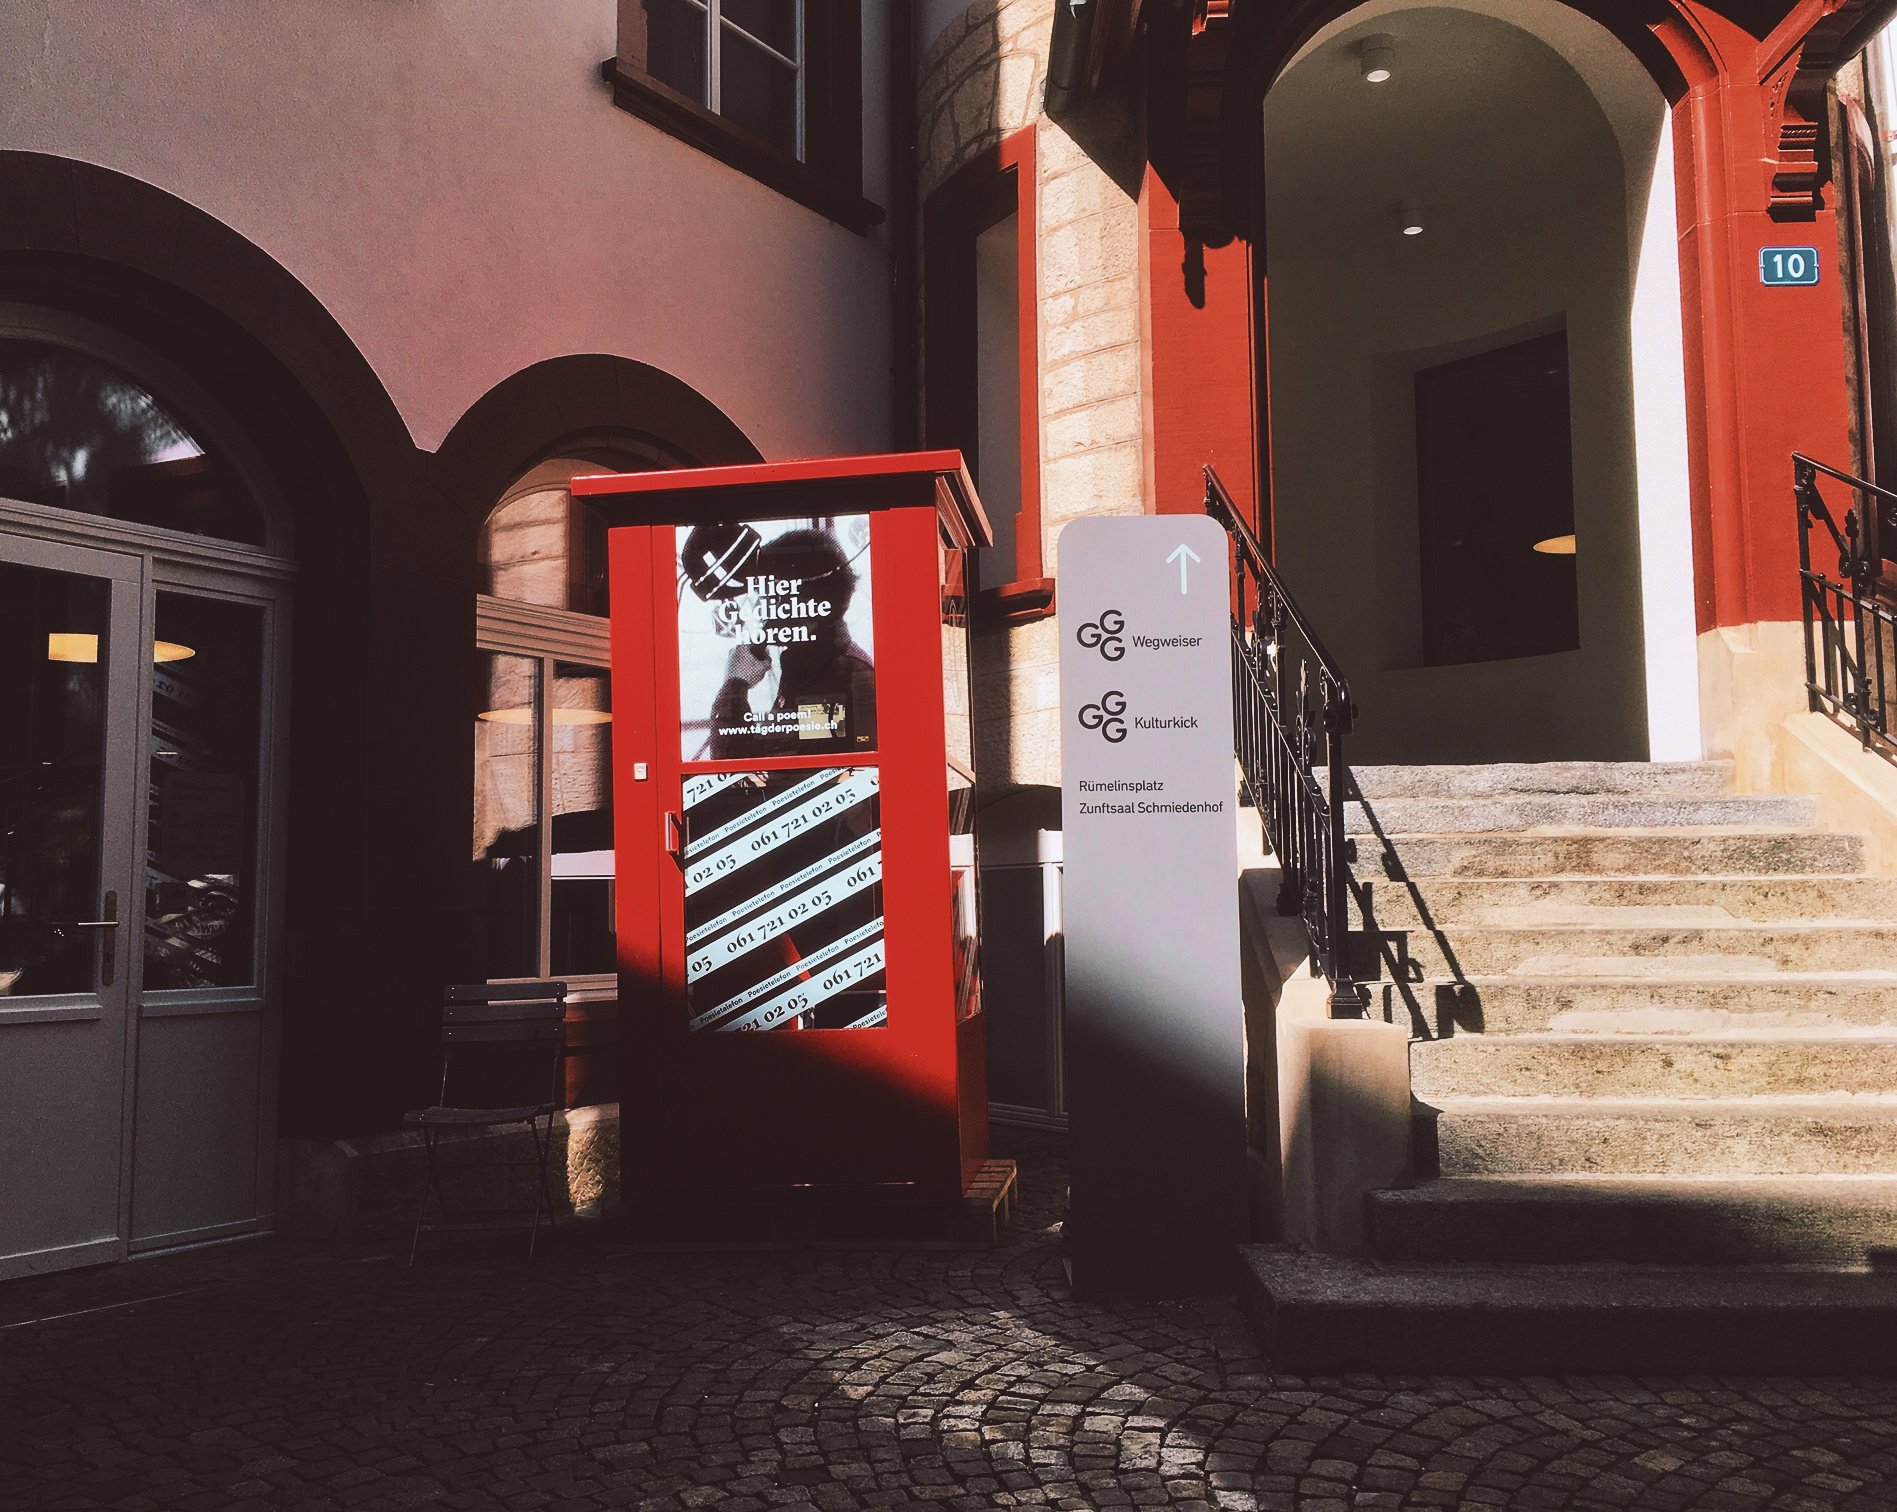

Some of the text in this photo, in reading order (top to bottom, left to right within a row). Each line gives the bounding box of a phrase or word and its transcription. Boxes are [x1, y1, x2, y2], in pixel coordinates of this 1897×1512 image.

[1773, 253, 1805, 278] 10
[745, 574, 802, 597] Hier
[718, 596, 832, 623] Gedichte
[1132, 634, 1203, 650] Wegweiser
[718, 719, 838, 736] www.tagderpoesie.ch
[743, 712, 765, 722] Call
[767, 713, 774, 721] a
[776, 709, 812, 722] poem!
[1134, 716, 1198, 729] Kulturkick
[686, 779, 715, 803] 721
[1079, 780, 1164, 793] Rümelinsplatz
[724, 806, 768, 834] Poesietelefon
[772, 780, 816, 807] Poesietelefon
[1079, 801, 1224, 814] Zunftsaal Schmiedenhof
[693, 788, 856, 883] 02 05 061 721 02 05
[731, 890, 776, 917] Poesietelefon
[780, 864, 824, 891] Poesietelefon
[827, 838, 872, 865] Poesietelefon
[691, 867, 876, 973] 05 061 721 02 05 061
[700, 997, 743, 1025] Poesietelefon
[747, 971, 791, 998] Poesietelefon
[796, 945, 840, 972] Poesietelefon
[764, 1005, 786, 1023] 02
[787, 992, 808, 1010] 05
[823, 969, 852, 991] 061
[853, 952, 882, 978] 721
